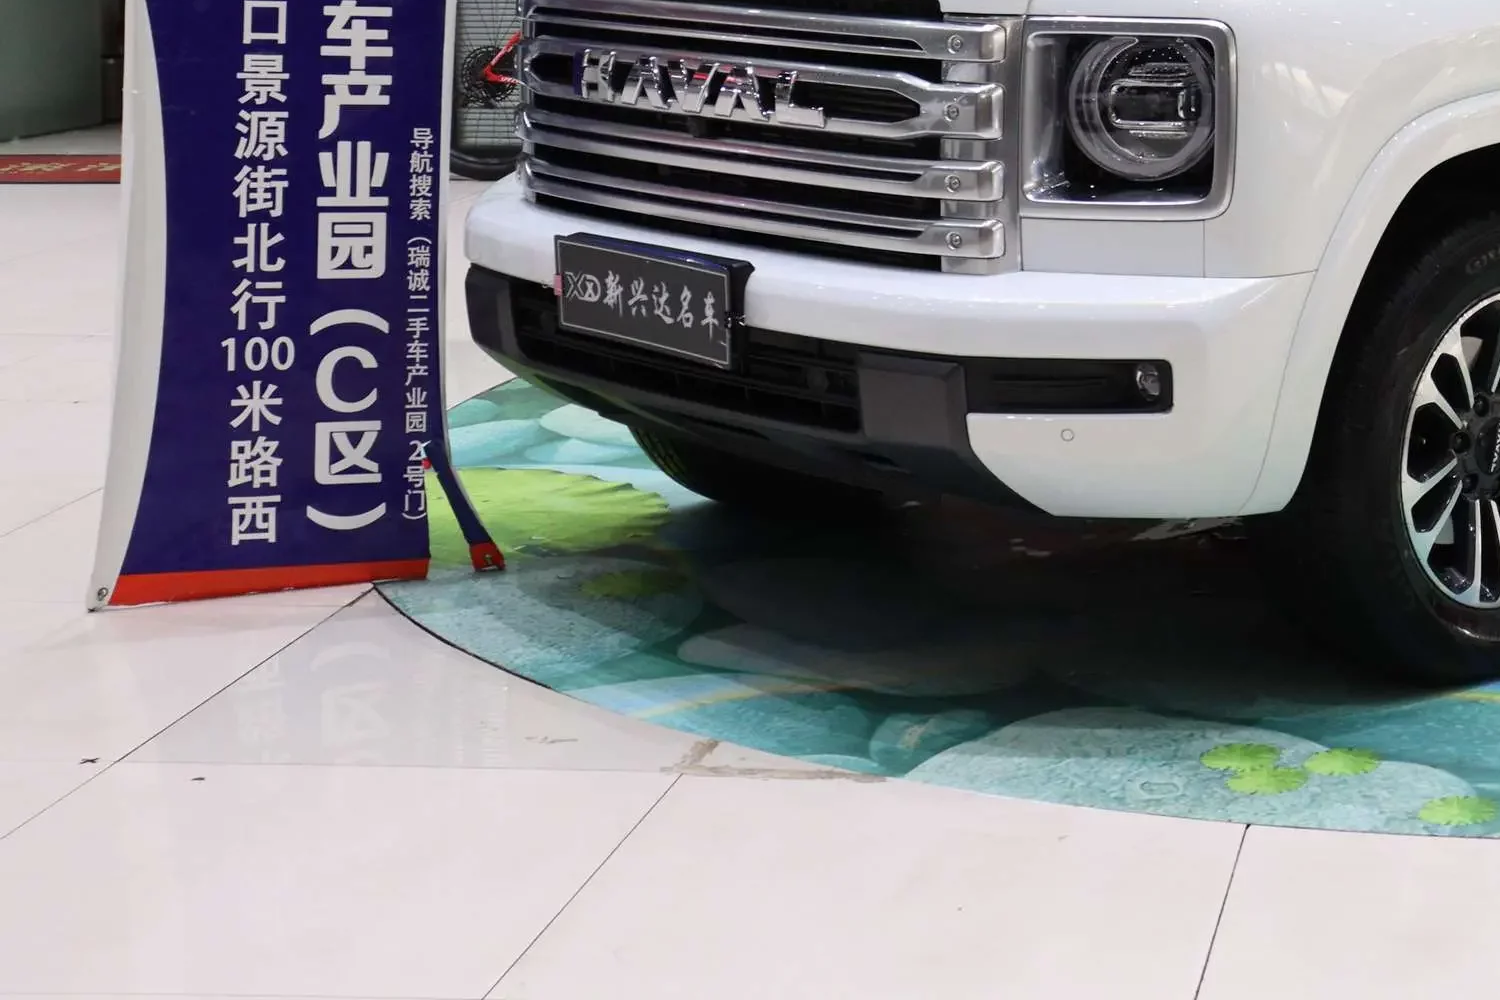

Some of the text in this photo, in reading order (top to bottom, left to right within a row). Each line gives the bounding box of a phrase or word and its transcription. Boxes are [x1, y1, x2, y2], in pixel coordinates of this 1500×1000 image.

[581, 49, 826, 129] HAVAL
[603, 270, 719, 343] 新兴达名车
